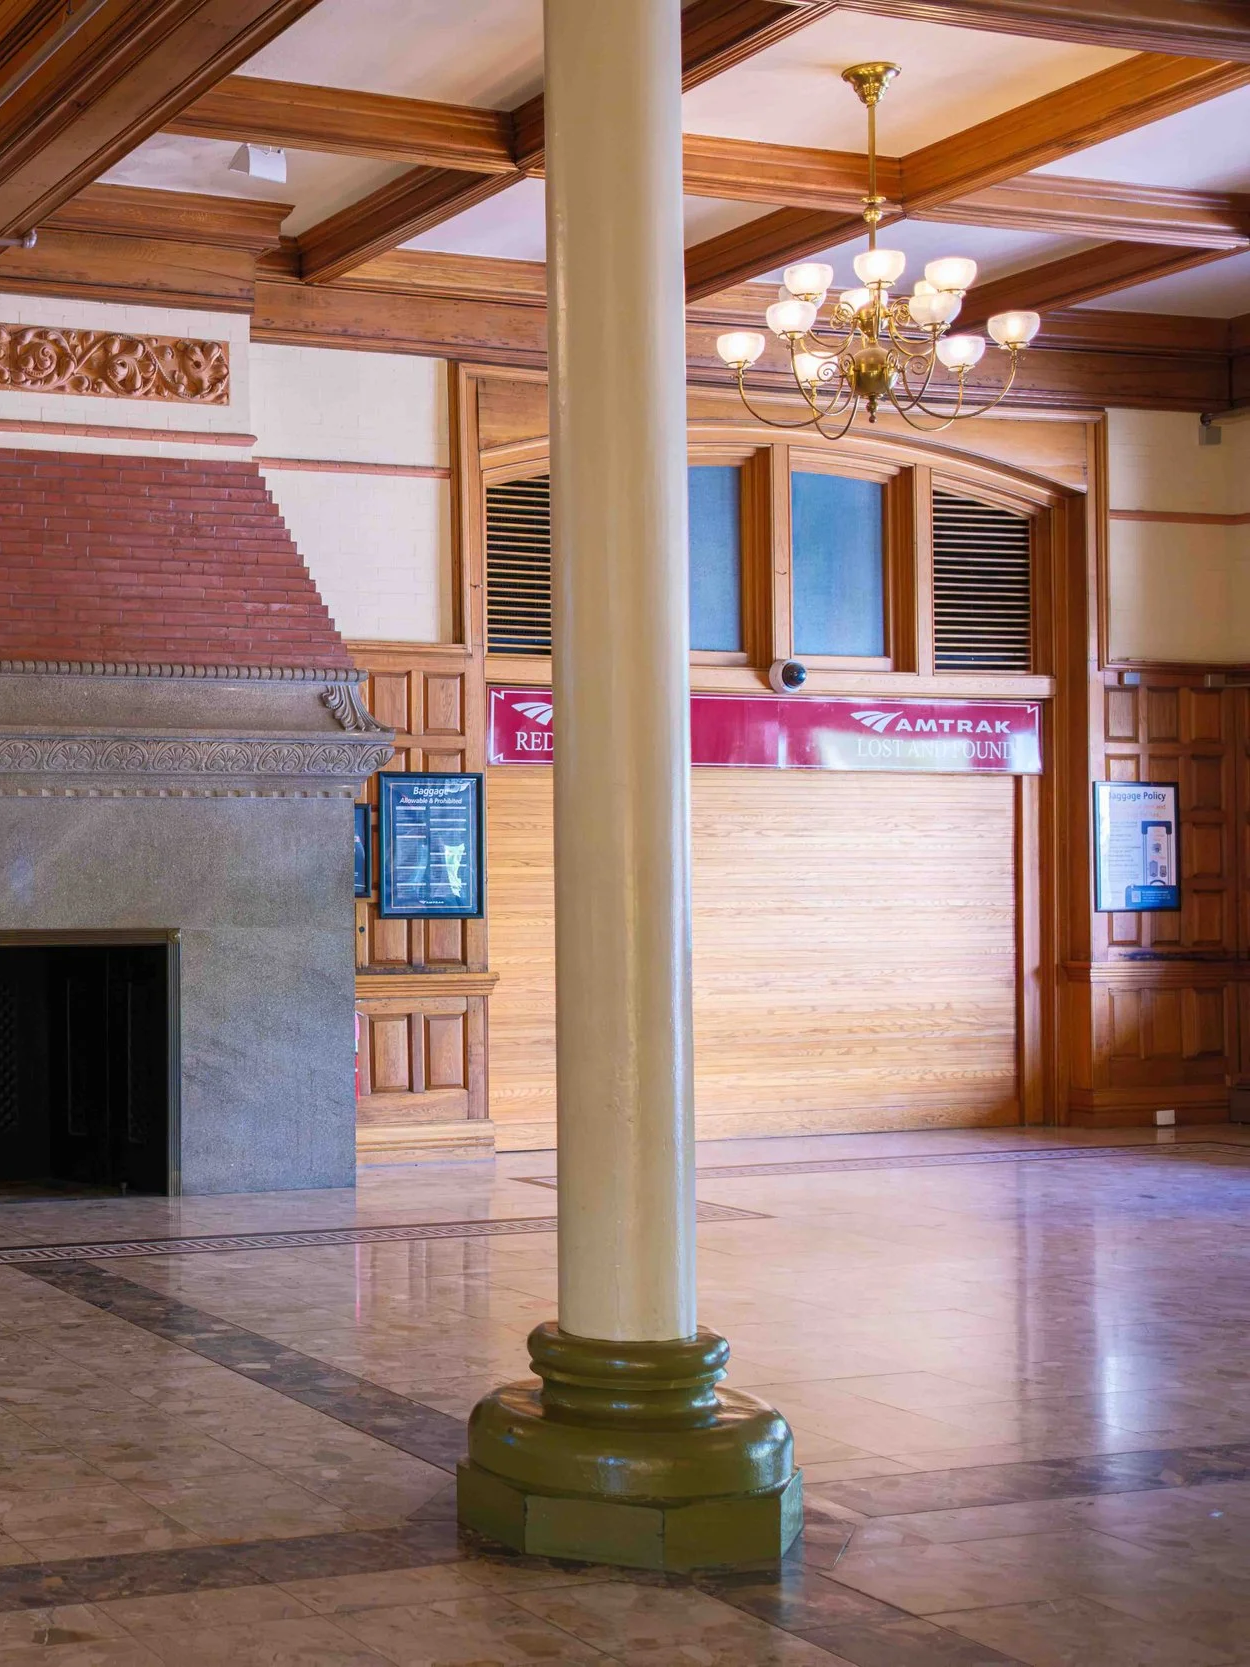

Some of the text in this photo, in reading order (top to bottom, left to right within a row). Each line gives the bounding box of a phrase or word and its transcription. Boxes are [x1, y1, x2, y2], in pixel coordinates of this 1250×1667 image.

[895, 718, 1011, 734] AMTRAK
[857, 738, 904, 758] LOST
[907, 740, 947, 759] AND
[413, 786, 448, 796] Baggage
[1143, 791, 1166, 802] Policy
